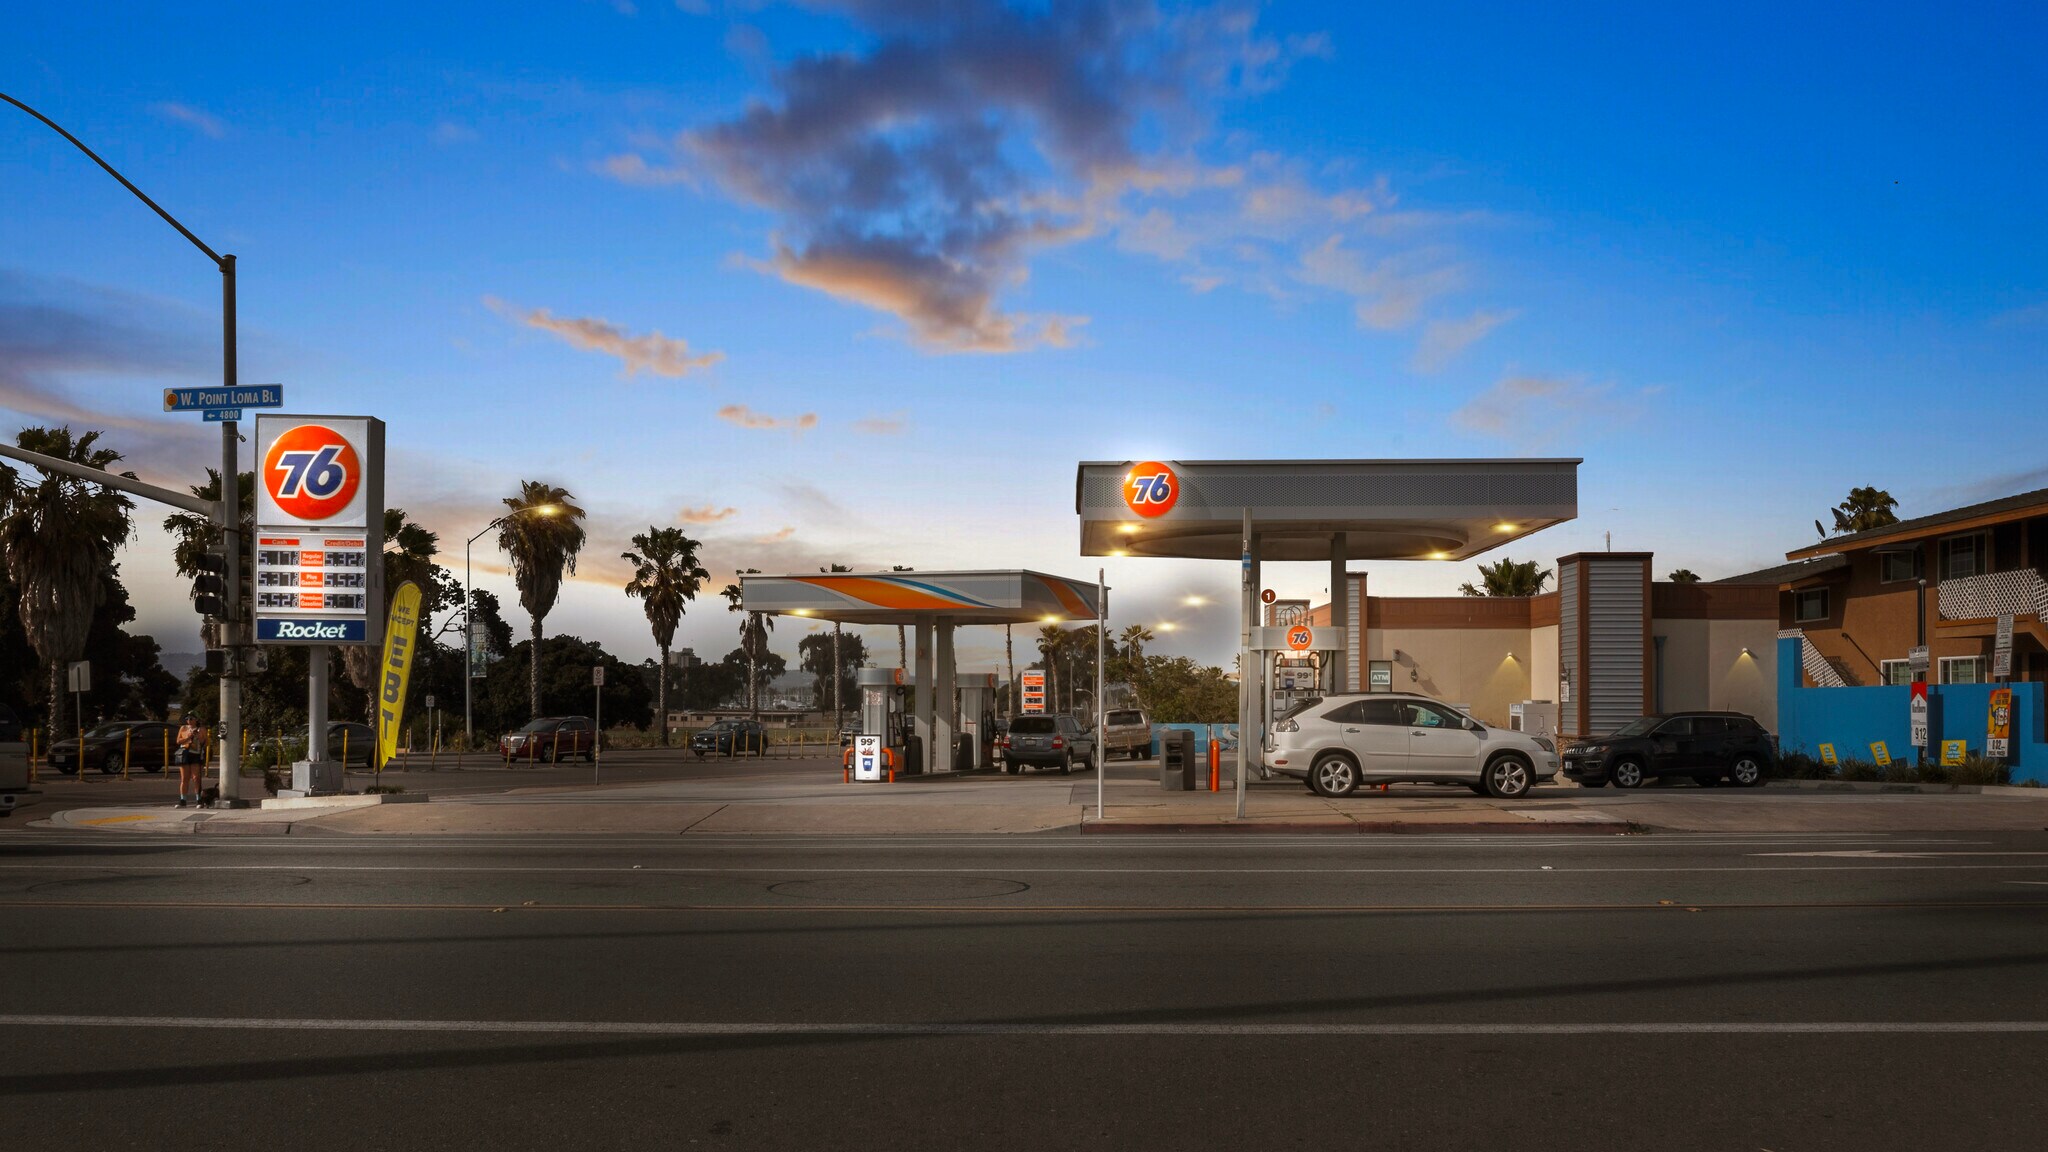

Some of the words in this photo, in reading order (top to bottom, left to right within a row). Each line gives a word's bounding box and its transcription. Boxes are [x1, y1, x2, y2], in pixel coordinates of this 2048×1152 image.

[181, 392, 194, 406] W.
[198, 392, 228, 405] POINT
[231, 390, 259, 404] LOMA
[262, 389, 278, 403] BL.
[219, 410, 239, 419] 4800
[275, 444, 346, 500] 76
[1132, 472, 1171, 504] 76
[398, 605, 411, 615] WE
[276, 621, 347, 639] Rocket
[1292, 631, 1309, 644] 76
[382, 634, 408, 740] EBT
